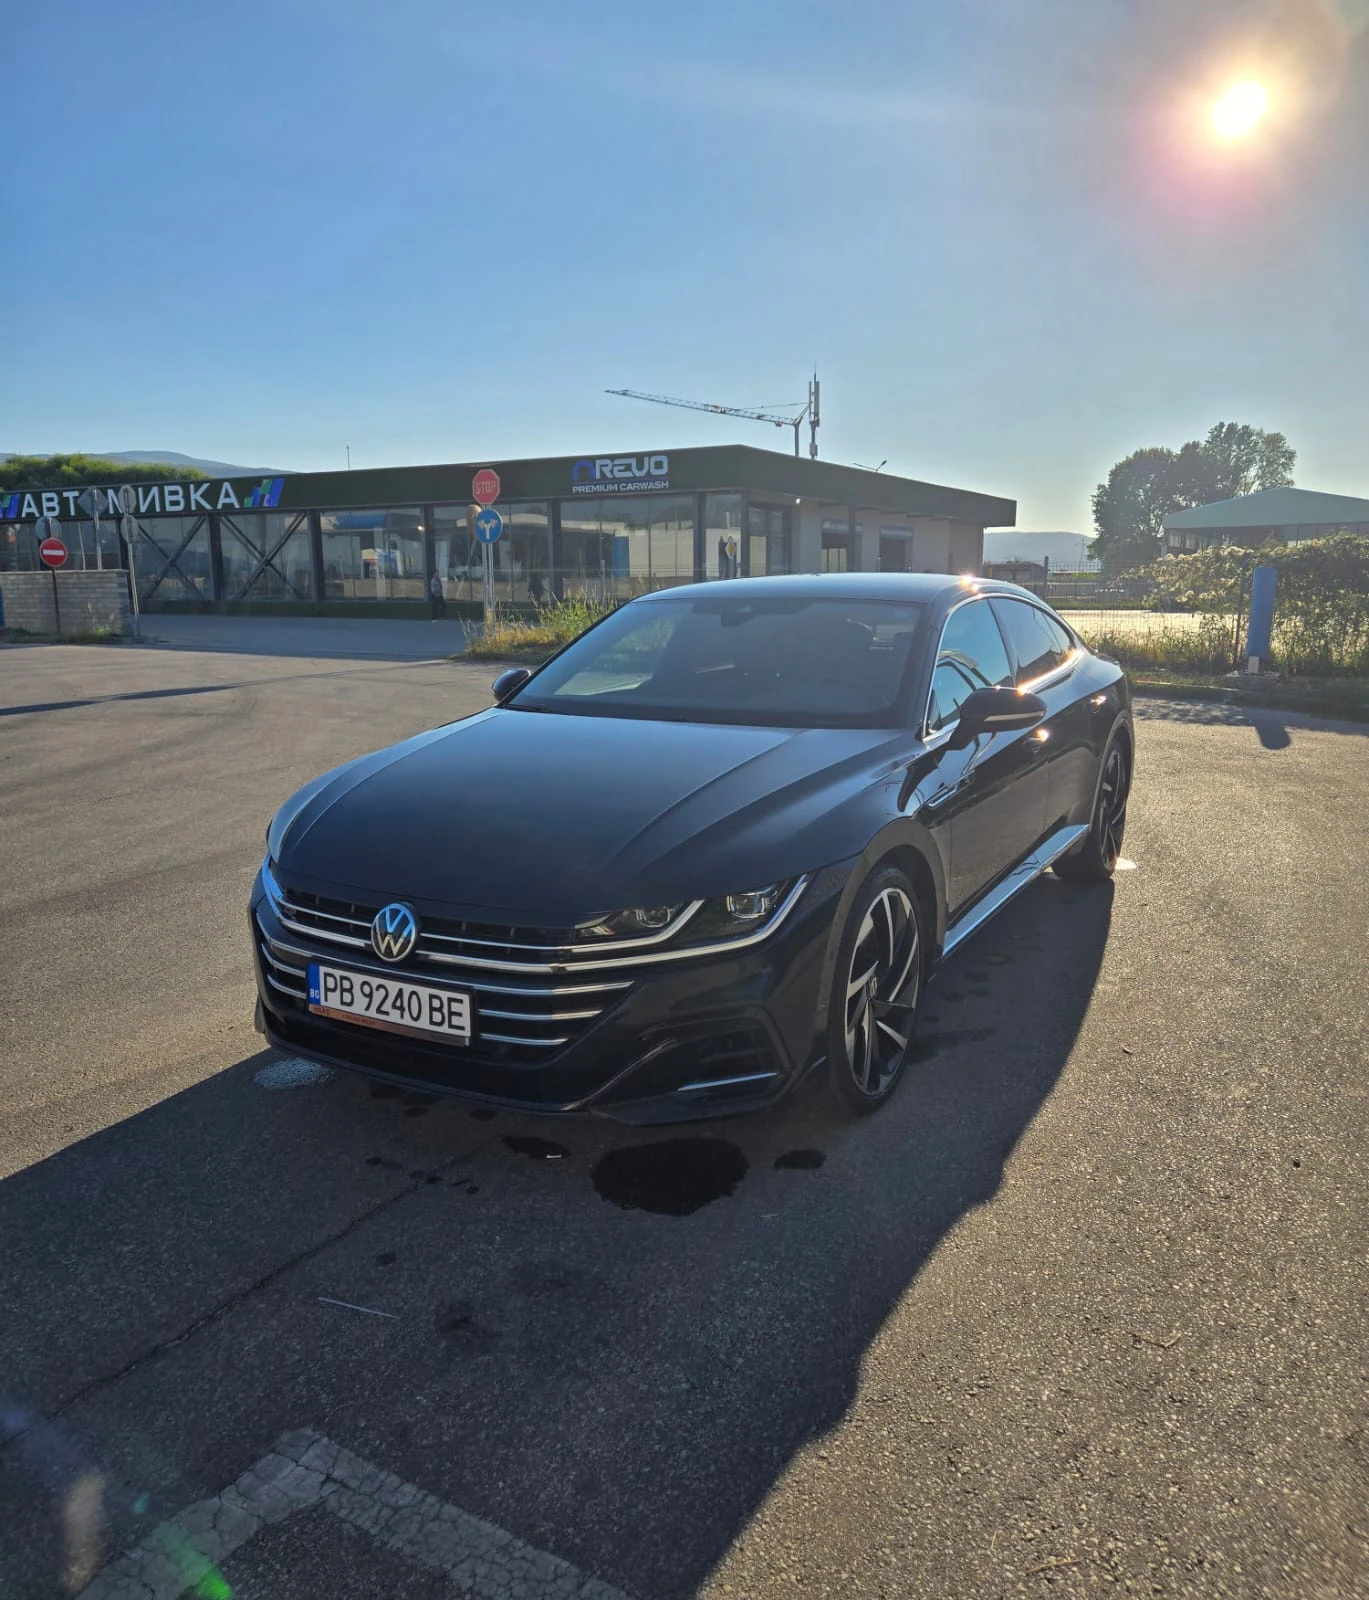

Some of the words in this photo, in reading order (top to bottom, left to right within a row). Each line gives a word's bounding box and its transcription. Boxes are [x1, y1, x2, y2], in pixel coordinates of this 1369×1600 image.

[595, 455, 669, 480] REVO
[475, 481, 496, 495] STOP
[572, 484, 618, 494] PREMIUM
[619, 480, 669, 491] CARWASH
[21, 481, 240, 518] АВТМИВКА
[309, 988, 320, 999] BG
[323, 972, 355, 1007] PB
[360, 980, 422, 1022] 9240
[428, 993, 466, 1031] BE
